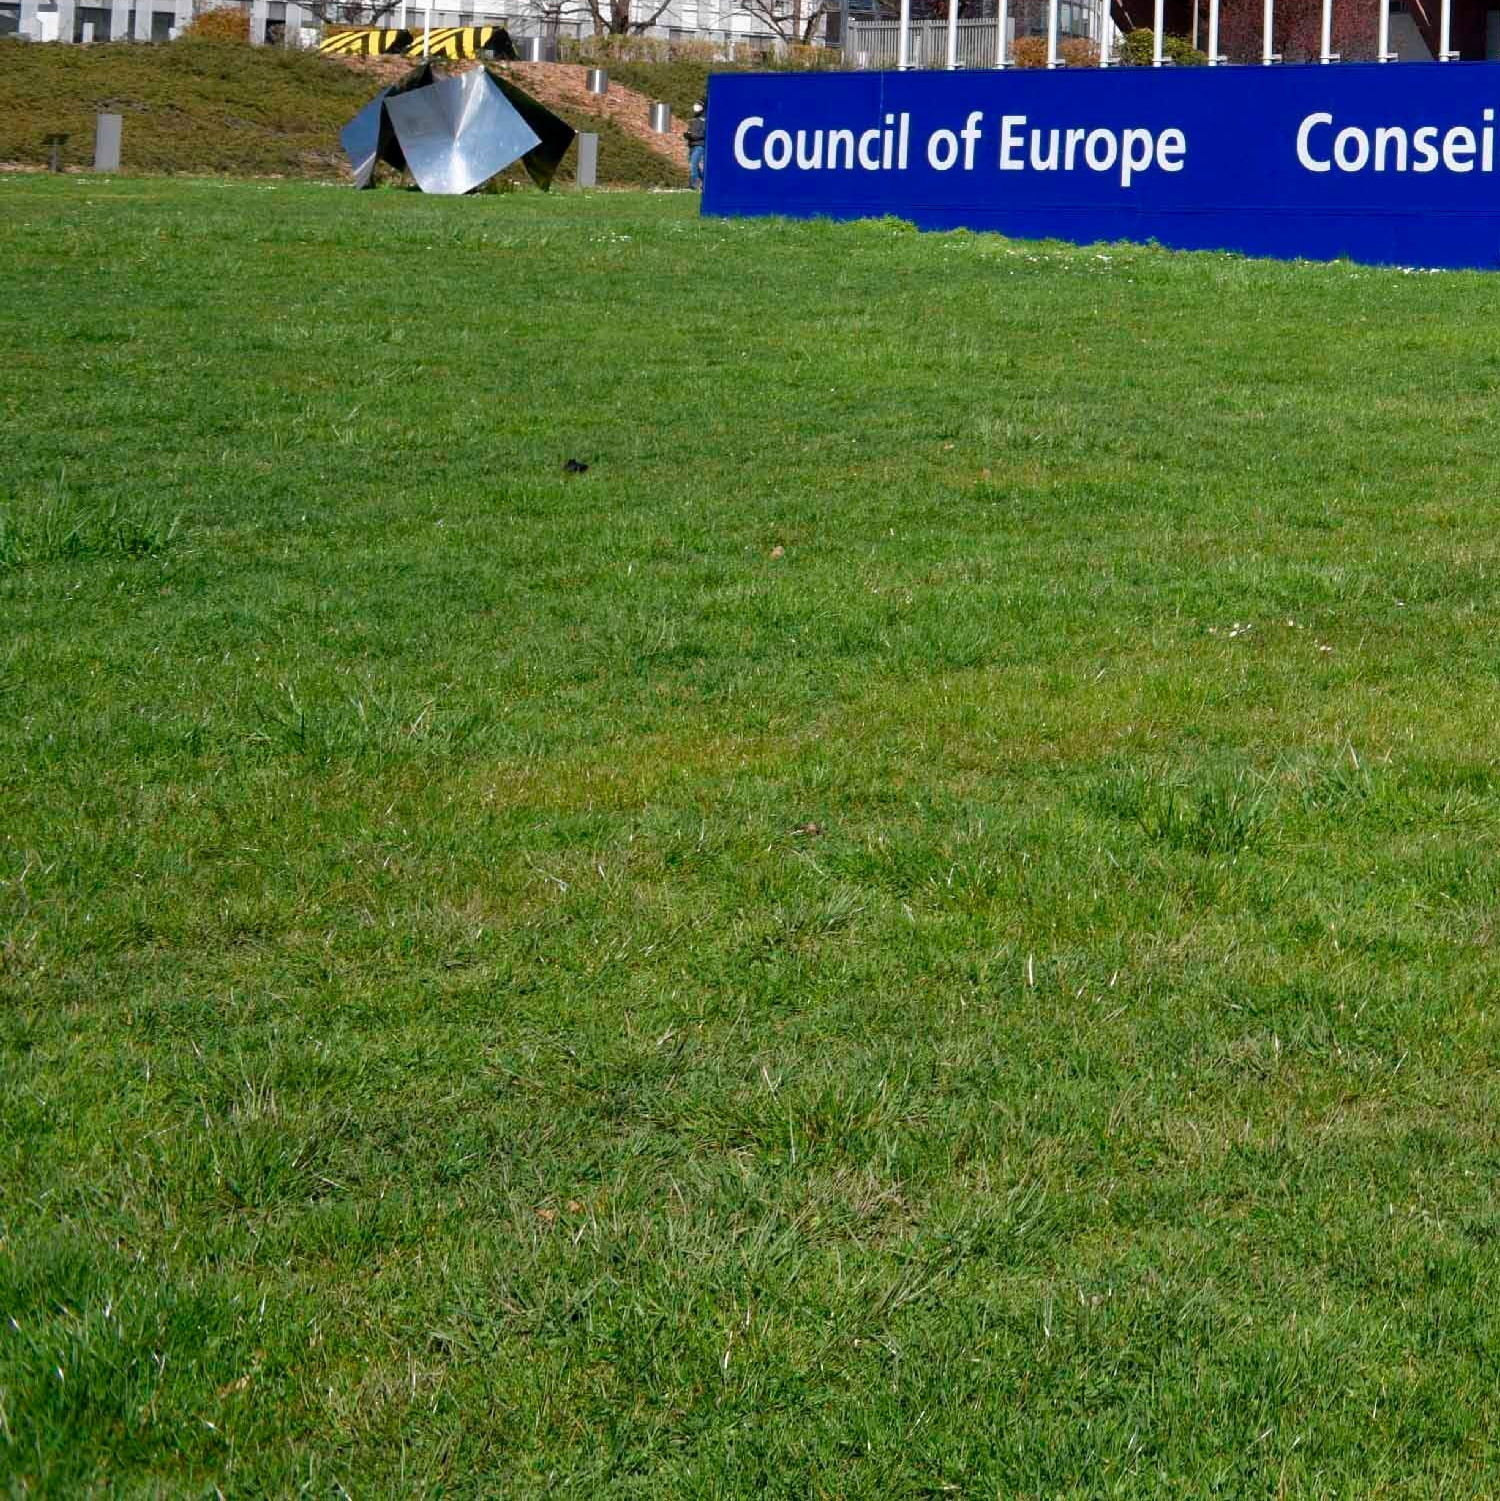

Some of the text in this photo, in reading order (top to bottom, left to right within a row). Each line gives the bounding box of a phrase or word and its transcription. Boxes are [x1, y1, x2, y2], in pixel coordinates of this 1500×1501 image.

[733, 110, 1188, 188] Council of Europe
